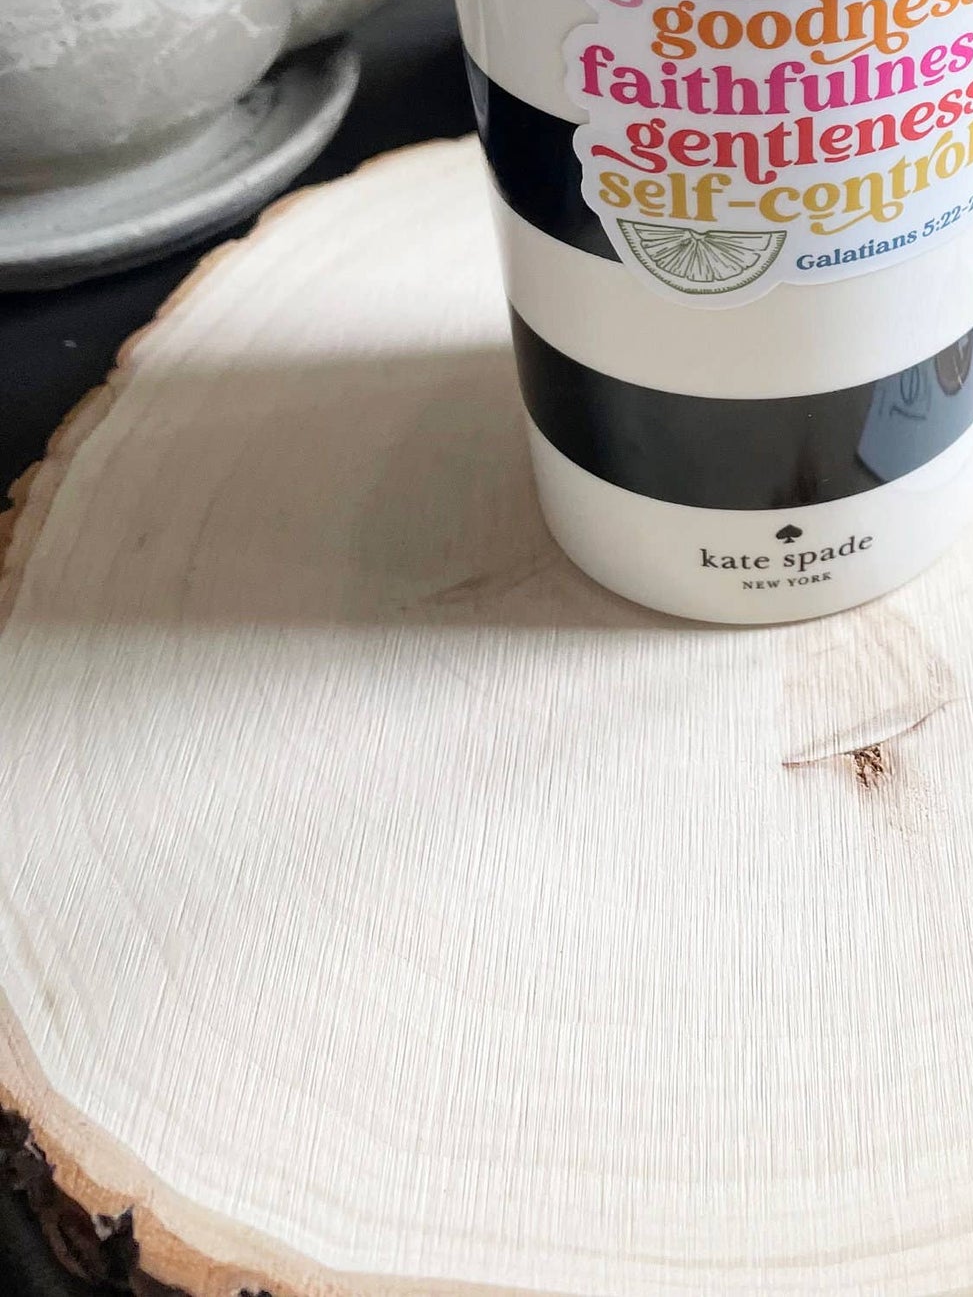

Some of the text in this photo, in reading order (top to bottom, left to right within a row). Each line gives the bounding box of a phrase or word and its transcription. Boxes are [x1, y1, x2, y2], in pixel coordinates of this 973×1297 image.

[796, 228, 918, 271] Galatians
[699, 535, 874, 572] kate spade
[742, 571, 832, 590] NEW YORK
